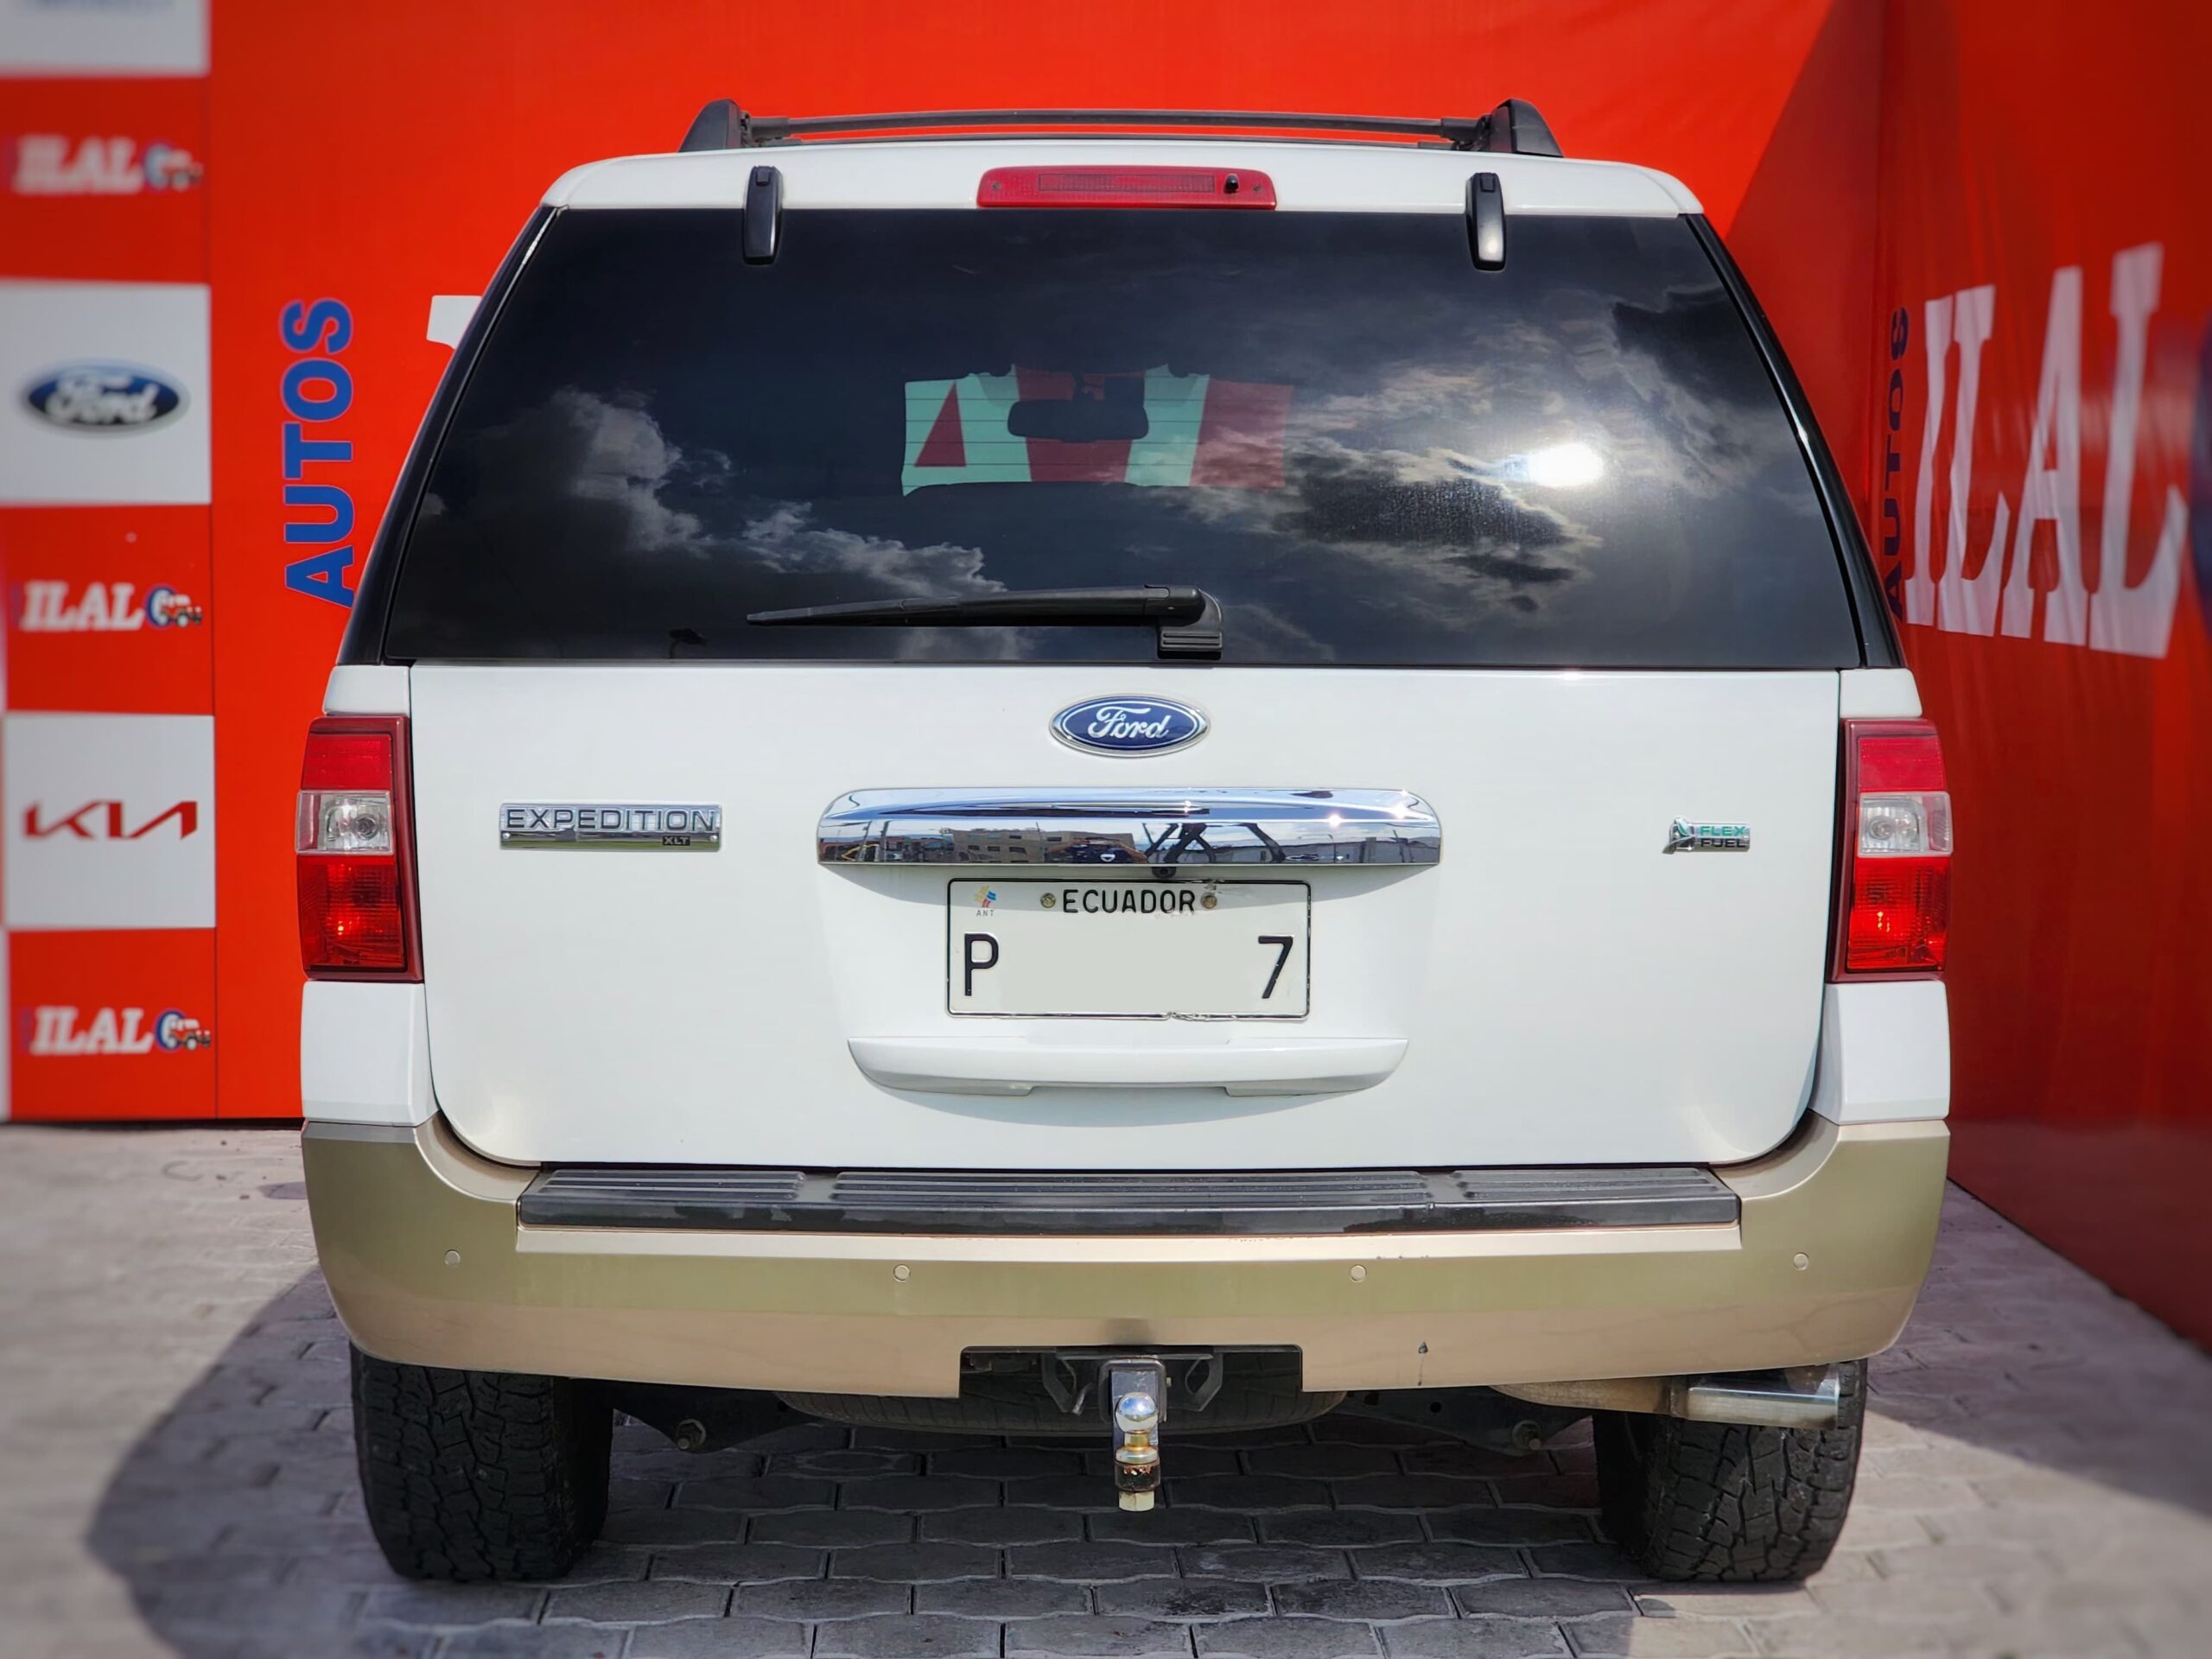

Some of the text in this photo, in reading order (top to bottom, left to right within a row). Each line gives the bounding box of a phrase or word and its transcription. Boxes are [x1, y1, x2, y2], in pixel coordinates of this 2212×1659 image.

[45, 372, 159, 424] Ford
[279, 297, 354, 608] AUTOS
[1883, 307, 1910, 623] AUTOS
[1904, 240, 2189, 659] ILAL
[20, 580, 145, 632] ILAL
[1087, 705, 1172, 740] Ford
[506, 808, 715, 832] EXPEDITION
[664, 836, 690, 846] XLT
[1700, 825, 1746, 836] FLEX
[1700, 837, 1746, 848] FUEL
[1062, 888, 1197, 914] ECUADOR
[29, 1006, 156, 1056] ILAL
